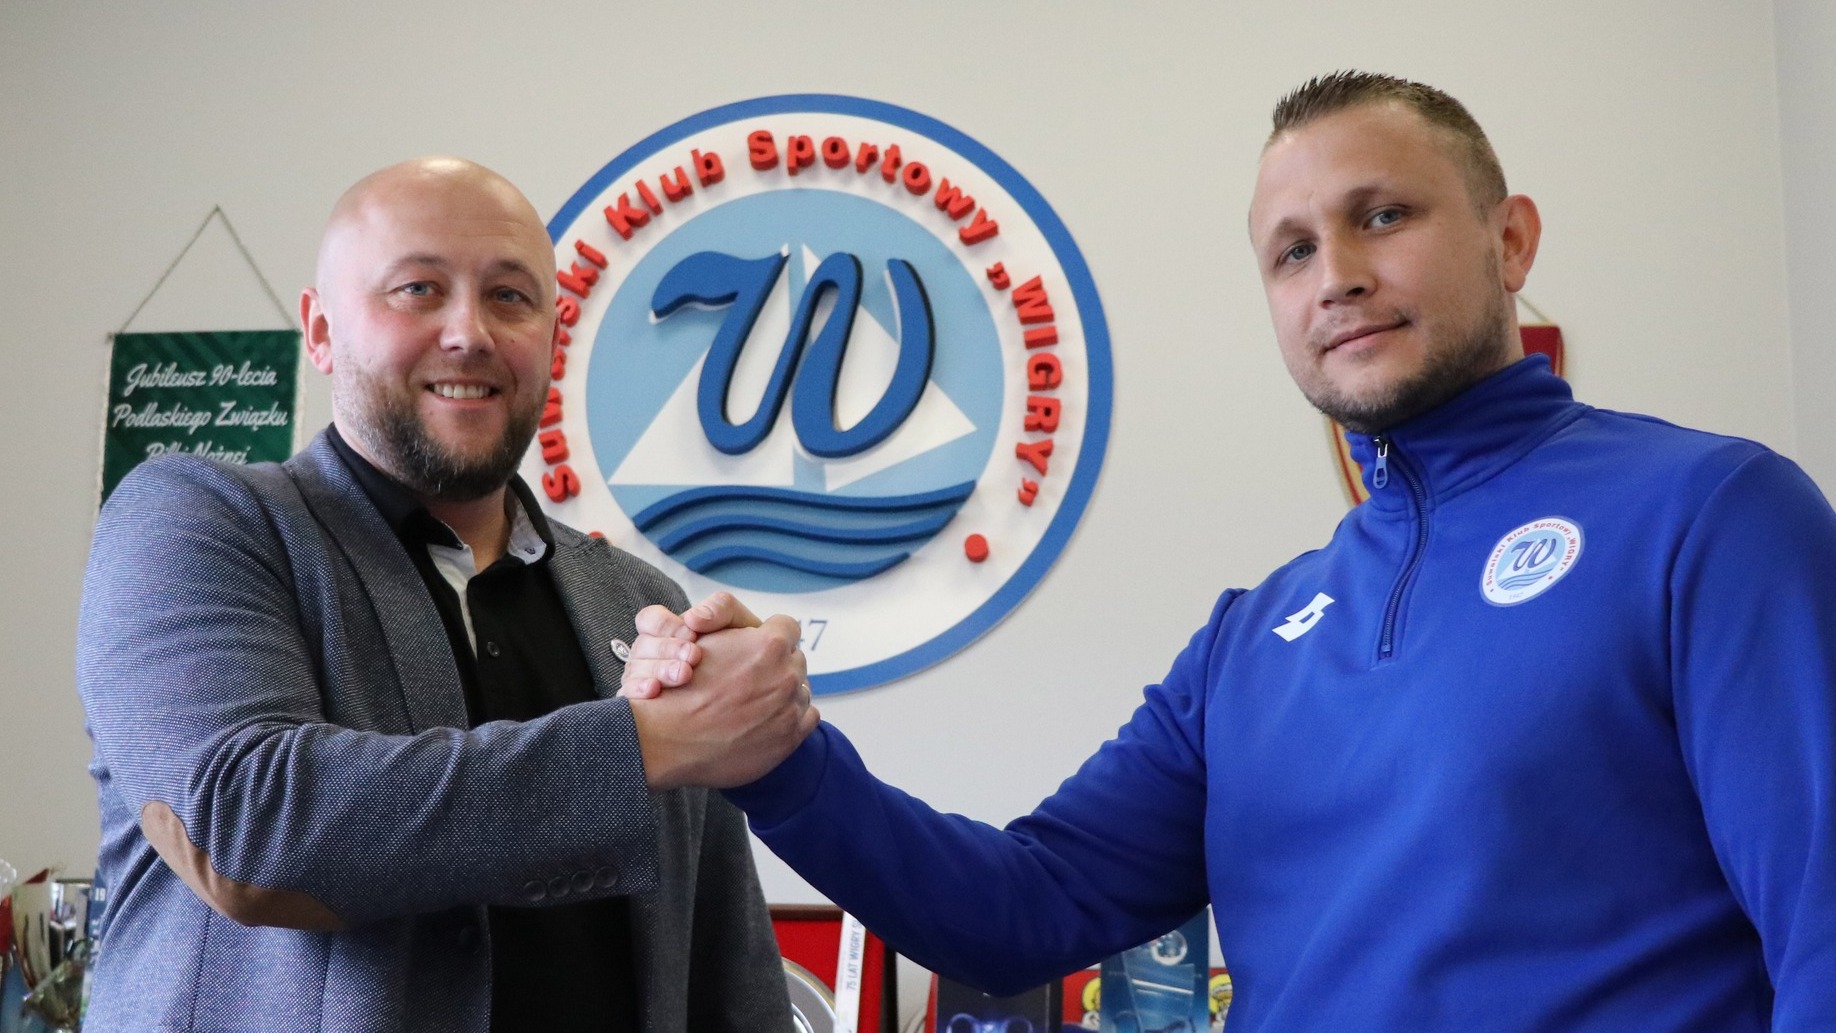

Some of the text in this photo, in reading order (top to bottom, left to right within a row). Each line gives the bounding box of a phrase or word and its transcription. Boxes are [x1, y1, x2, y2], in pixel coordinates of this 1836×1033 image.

[603, 148, 725, 241] Klub
[746, 130, 998, 246] Sportowy
[123, 360, 277, 397] Jubileusz 90-lecia
[112, 400, 288, 435] Podlaskiego Związku
[849, 930, 861, 959] WIGRY
[846, 981, 857, 990] 75
[847, 963, 858, 979] LAT
